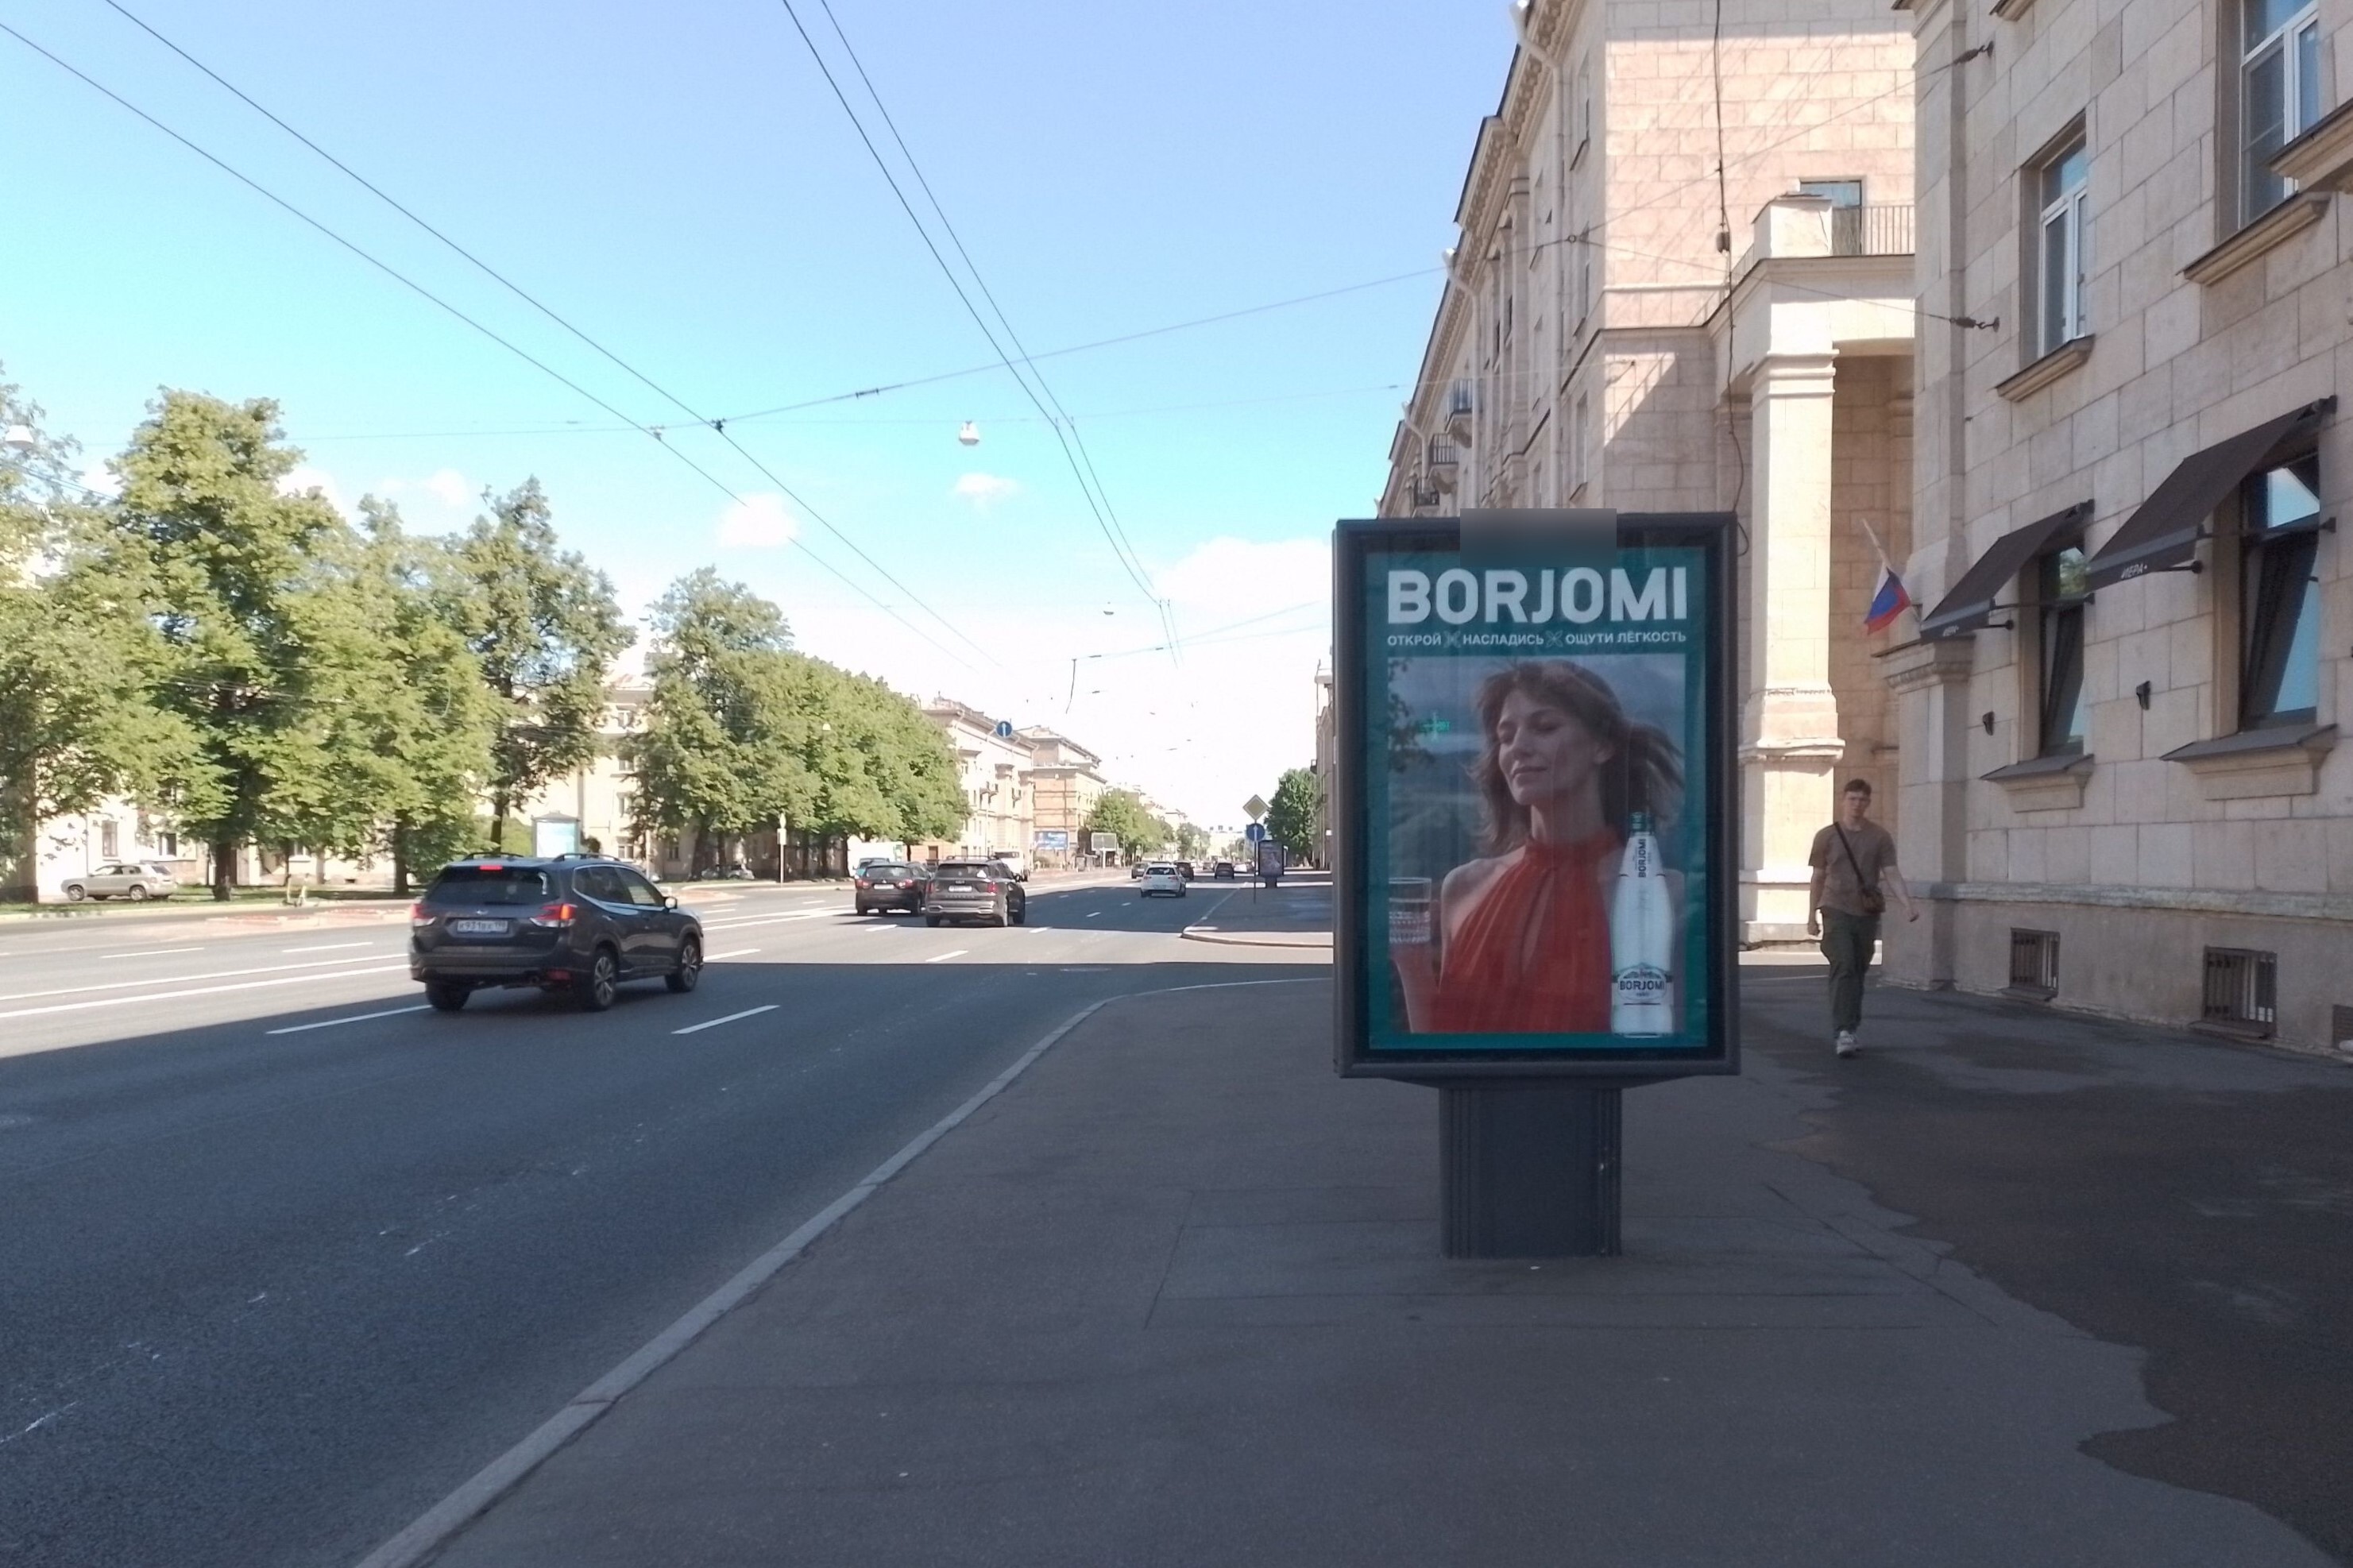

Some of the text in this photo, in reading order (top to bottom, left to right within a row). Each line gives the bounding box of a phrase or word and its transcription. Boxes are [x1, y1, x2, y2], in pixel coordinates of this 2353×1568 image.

[1388, 566, 1687, 624] BORJOMI
[1387, 631, 1687, 647] ОТКРОЙ НАСЛАДИСЬ ОЩУТИ ЛЁГКОСТЬ
[1638, 838, 1647, 878] BORJOMI
[1620, 980, 1664, 991] BORJOMI
